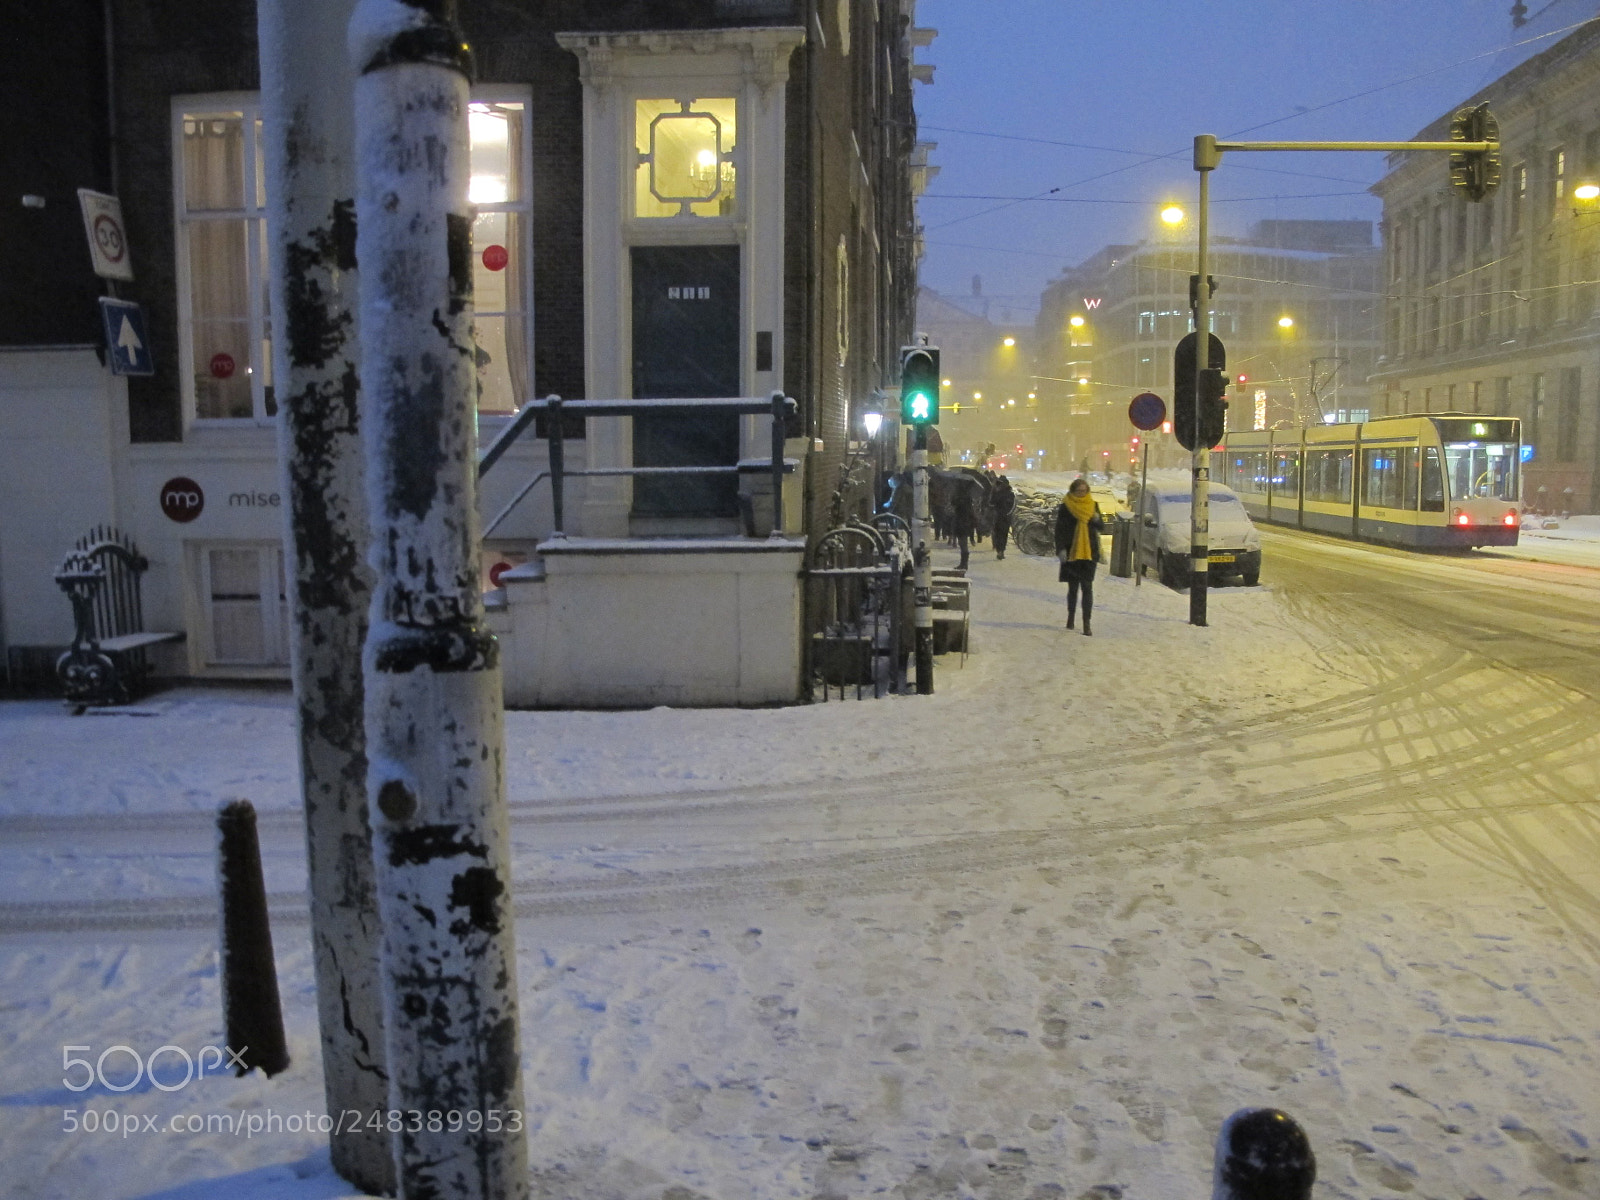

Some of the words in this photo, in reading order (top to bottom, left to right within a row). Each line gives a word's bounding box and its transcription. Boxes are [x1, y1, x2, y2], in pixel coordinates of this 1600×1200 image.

[100, 228, 120, 248] 30
[1084, 298, 1101, 310] W
[165, 491, 199, 509] mp
[229, 490, 281, 507] mise
